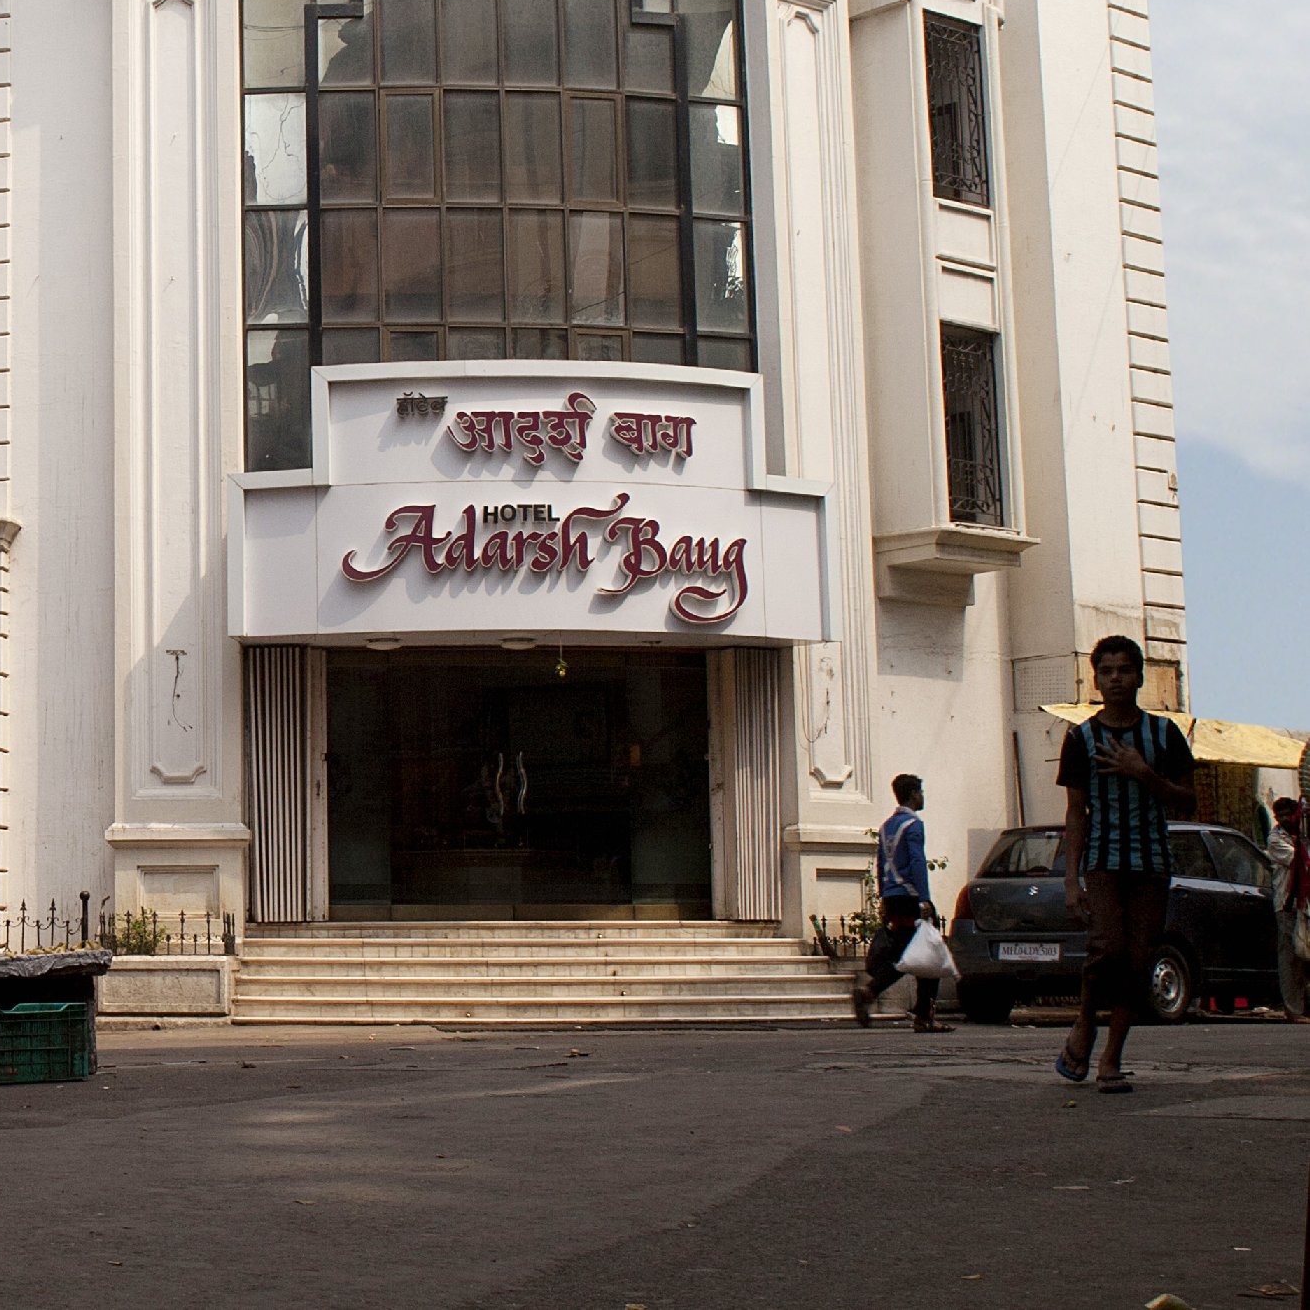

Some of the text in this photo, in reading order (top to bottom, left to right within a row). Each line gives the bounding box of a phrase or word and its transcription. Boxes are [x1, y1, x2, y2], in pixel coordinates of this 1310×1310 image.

[396, 391, 448, 416] हॉटेल
[447, 392, 697, 466] आदर्श बाग
[482, 503, 560, 525] HOTEL
[341, 491, 748, 624] Adarsh Baug
